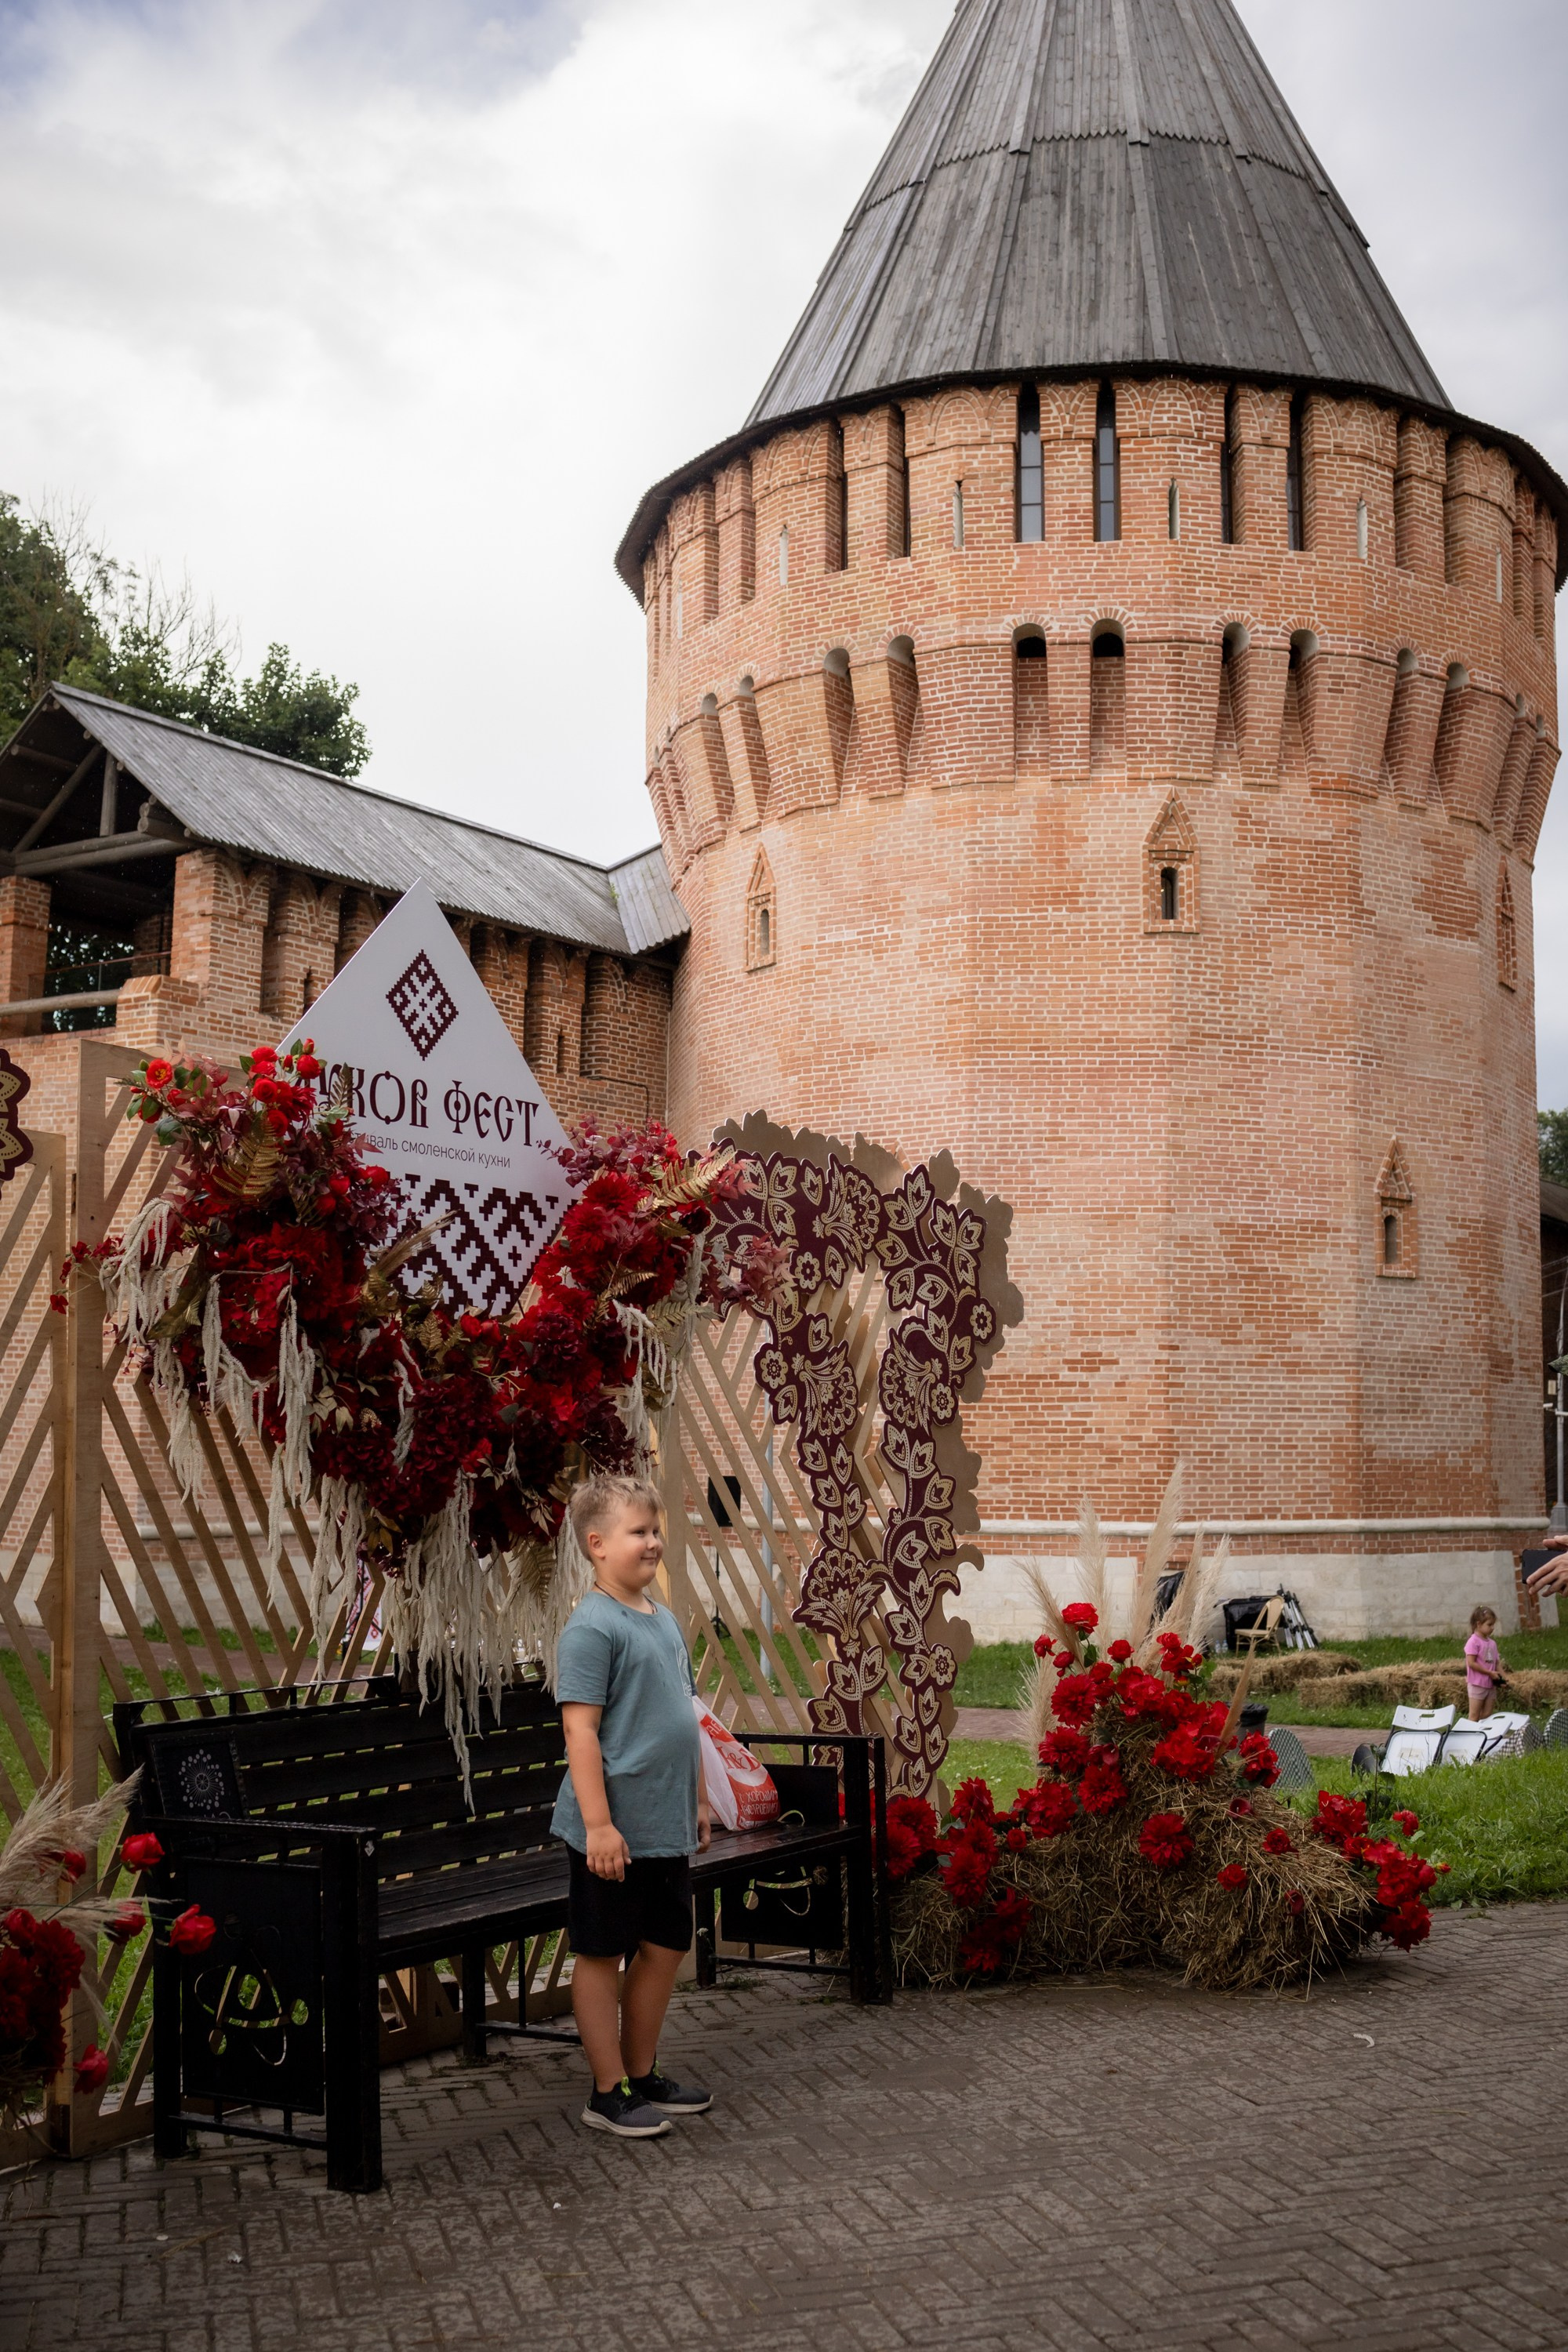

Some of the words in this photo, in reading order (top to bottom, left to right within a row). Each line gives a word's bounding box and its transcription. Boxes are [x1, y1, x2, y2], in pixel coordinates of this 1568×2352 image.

[293, 1063, 429, 1129] УКОВ
[444, 1080, 539, 1147] ФЕСТ
[401, 1140, 475, 1163] смоленской
[478, 1152, 510, 1169] кухни
